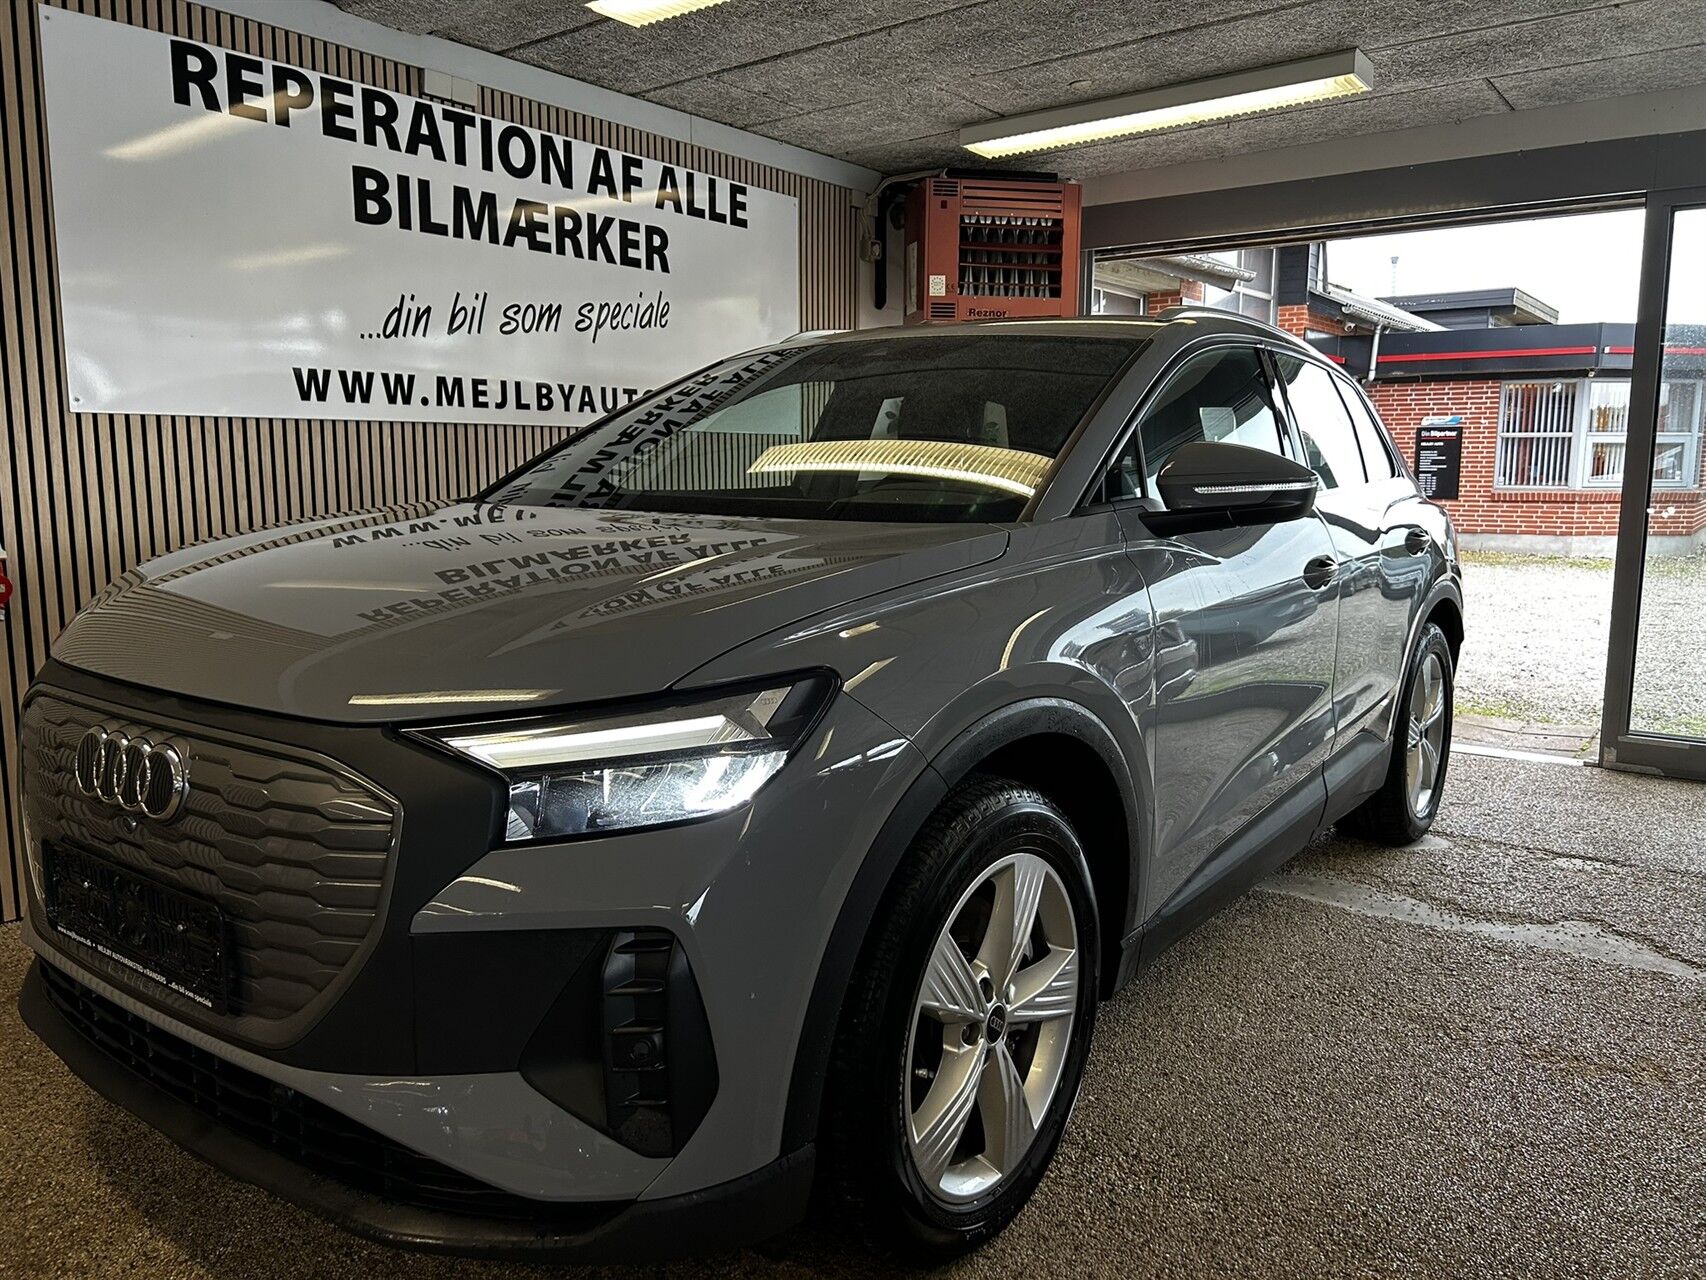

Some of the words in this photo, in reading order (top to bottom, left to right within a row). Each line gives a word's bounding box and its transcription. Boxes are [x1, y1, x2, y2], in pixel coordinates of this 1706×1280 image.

[170, 40, 574, 190] REPERATION
[587, 147, 645, 204] AF
[655, 165, 749, 230] ALLE
[351, 165, 671, 274] BILMÆRKER
[447, 291, 488, 336] bil
[499, 303, 563, 336] som
[574, 290, 671, 344] speciale
[968, 307, 1008, 318] Reznor
[293, 367, 655, 415] WWW.MEJLBYAUT
